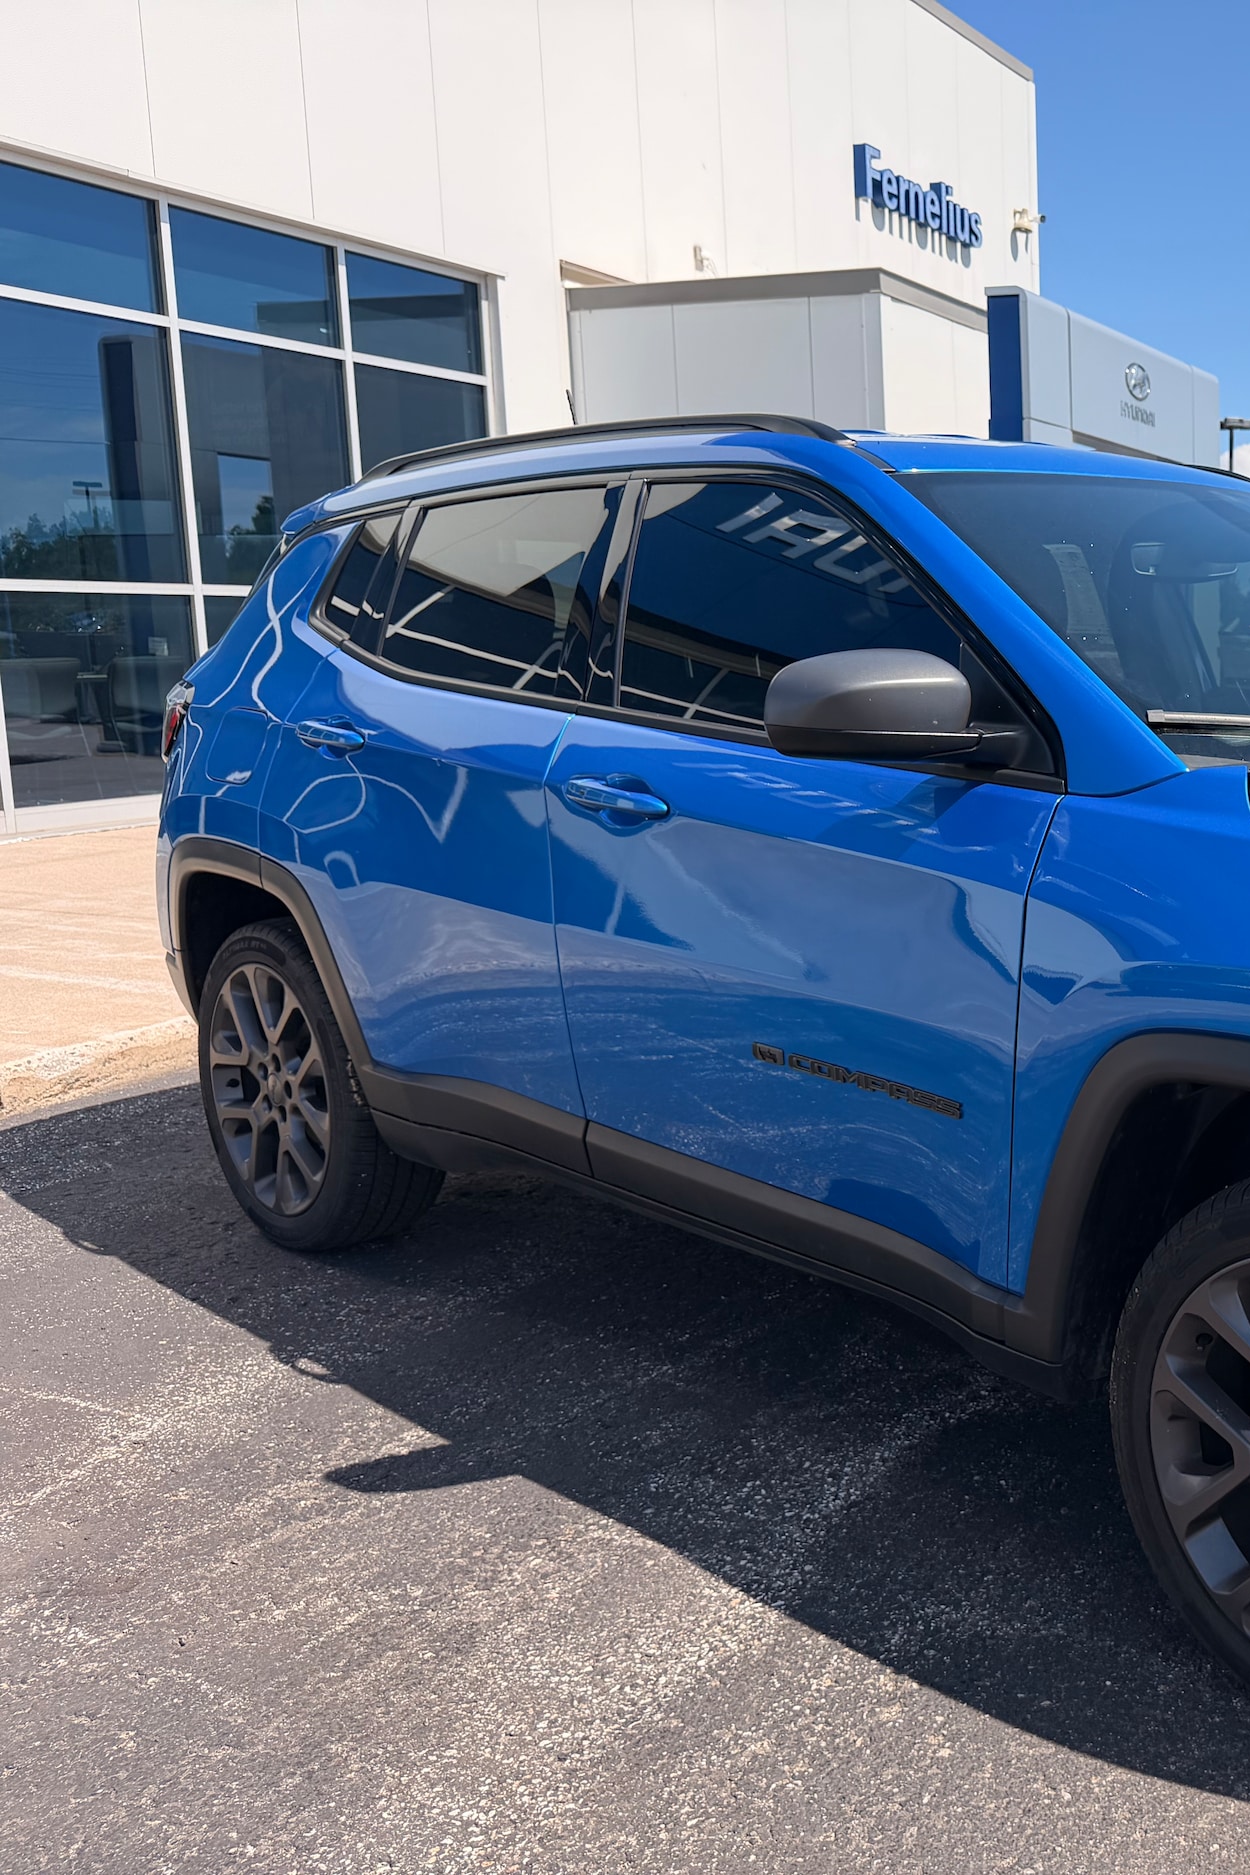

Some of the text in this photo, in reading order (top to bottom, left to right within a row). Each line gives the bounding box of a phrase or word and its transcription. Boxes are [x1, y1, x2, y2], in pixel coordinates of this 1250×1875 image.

[853, 143, 982, 248] Fernelius
[1120, 400, 1156, 427] HYUNDAI
[788, 1053, 964, 1120] COMPASS
